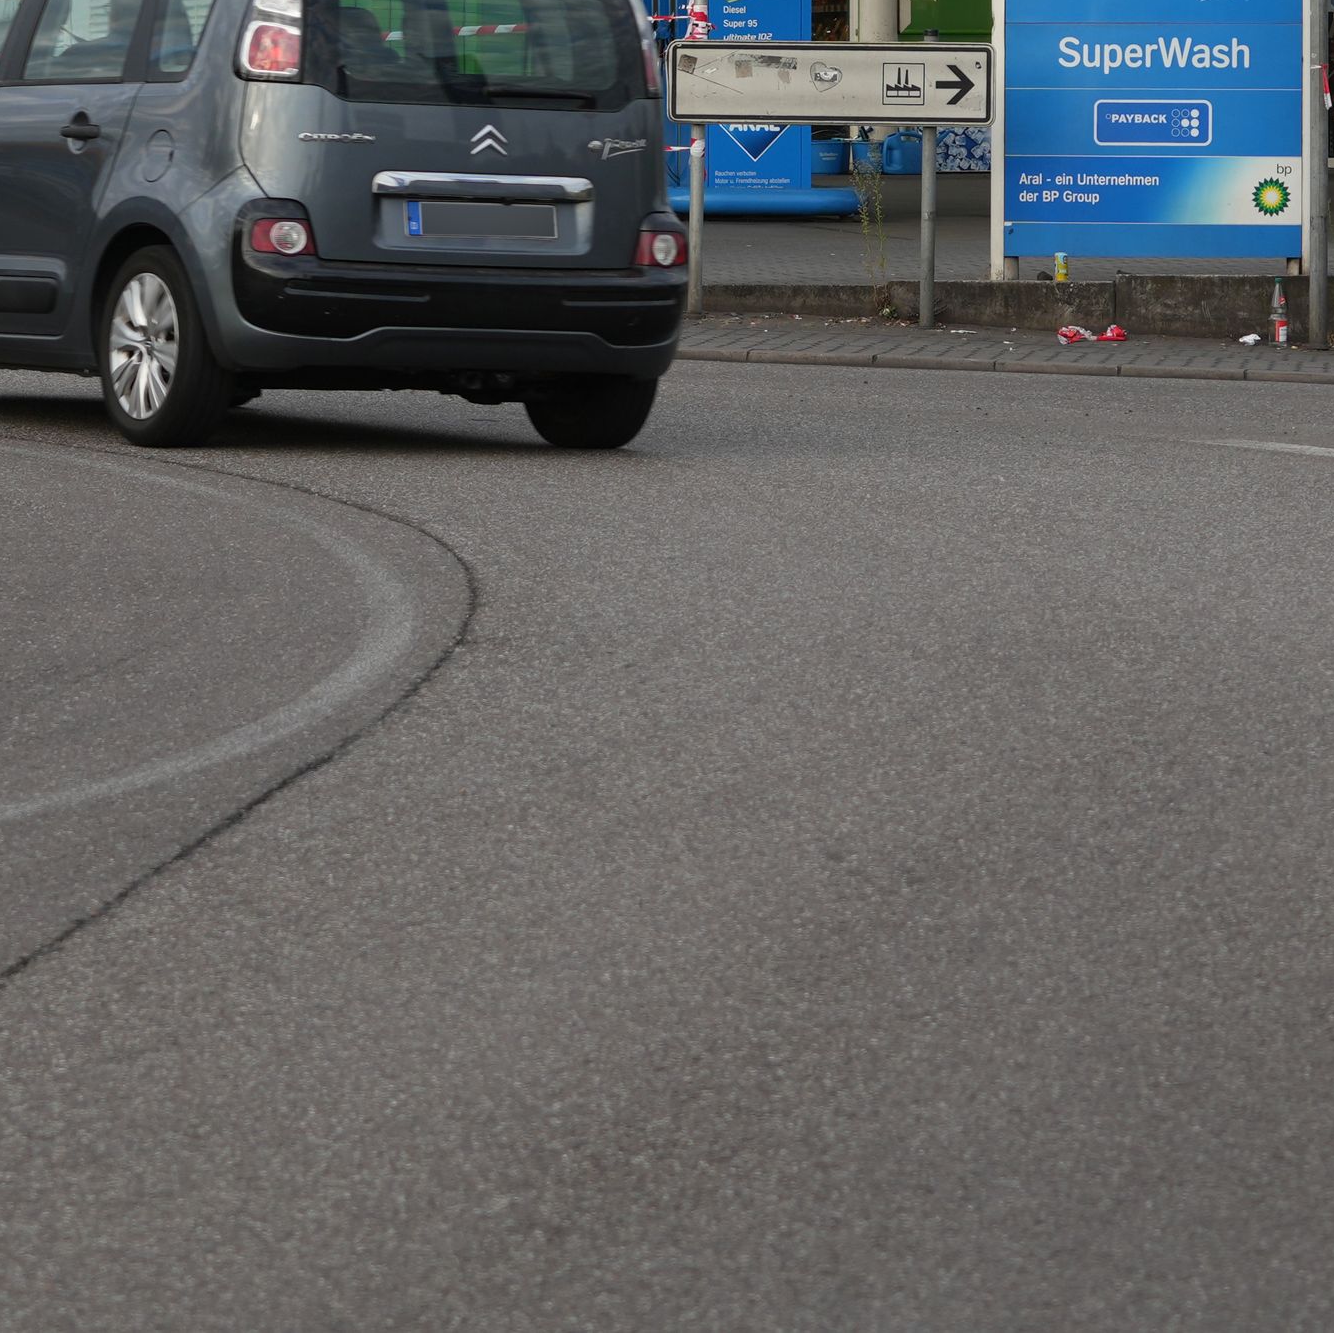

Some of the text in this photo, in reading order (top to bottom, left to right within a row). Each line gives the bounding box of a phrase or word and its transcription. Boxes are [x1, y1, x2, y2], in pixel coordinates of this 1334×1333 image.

[723, 5, 746, 14] Diesel
[723, 19, 758, 29] Super 95
[723, 32, 773, 40] ultimate 102
[1058, 35, 1251, 75] SuperWash
[1276, 163, 1293, 177] bp
[1019, 173, 1043, 185] Aral
[1055, 173, 1074, 185] ein
[1077, 173, 1160, 186] Unternehmen
[1019, 190, 1100, 205] der BP Group
